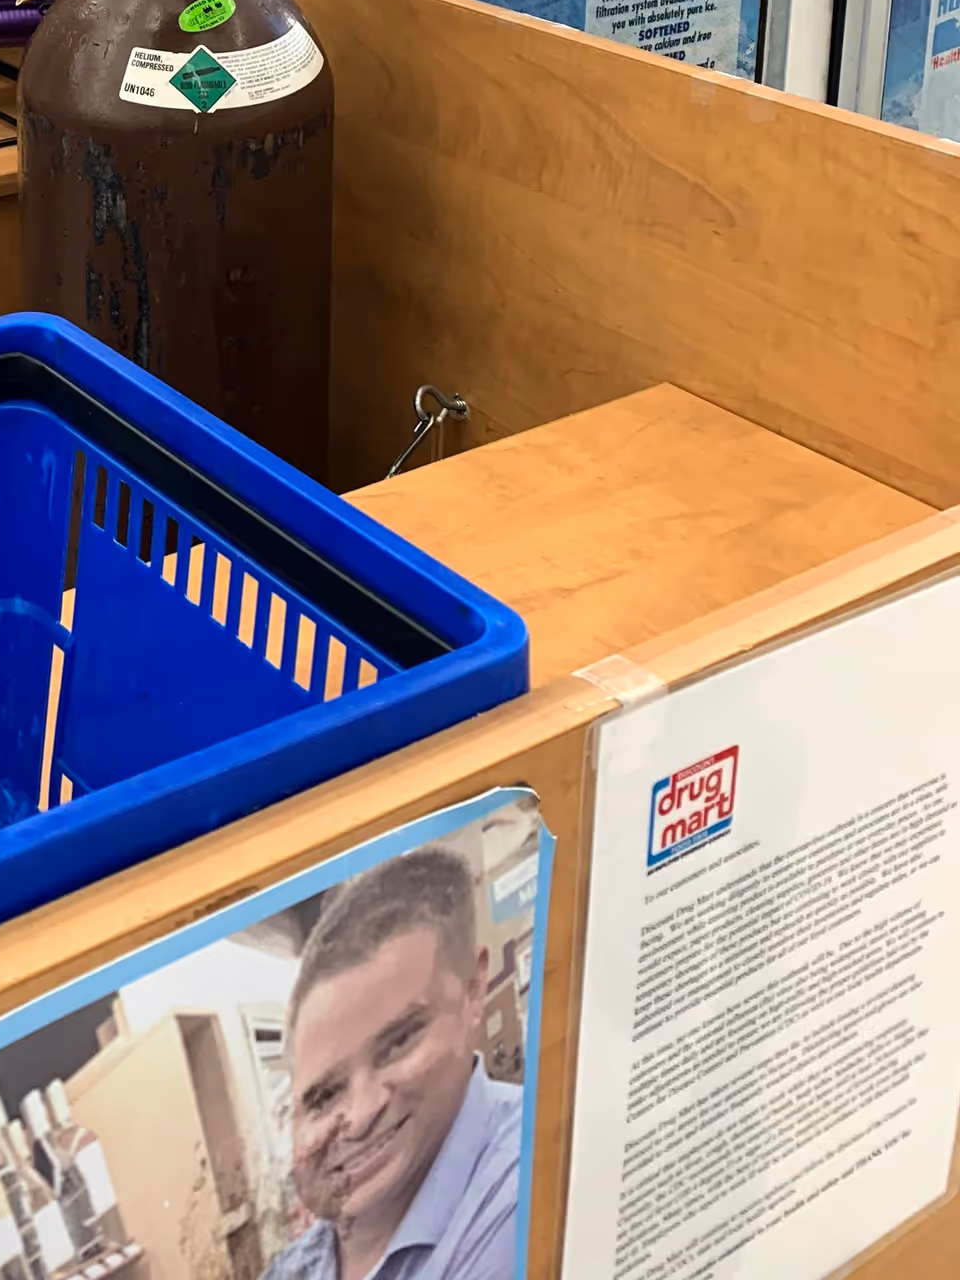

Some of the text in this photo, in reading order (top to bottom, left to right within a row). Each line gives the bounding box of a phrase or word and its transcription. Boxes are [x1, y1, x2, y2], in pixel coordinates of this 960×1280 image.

[185, 0, 206, 14] OWNED
[596, 4, 629, 19] filtration
[631, 0, 658, 13] system
[612, 2, 717, 34] you with absolutely pure ice.
[639, 21, 690, 41] SOFTENED
[654, 37, 680, 50] calcium
[682, 35, 695, 45] and
[697, 31, 711, 41] iron
[131, 59, 174, 72] COMPRESSED
[135, 51, 163, 63] HELIUM,
[124, 83, 155, 97] UN1046
[658, 768, 723, 816] drug
[661, 792, 729, 849] mart
